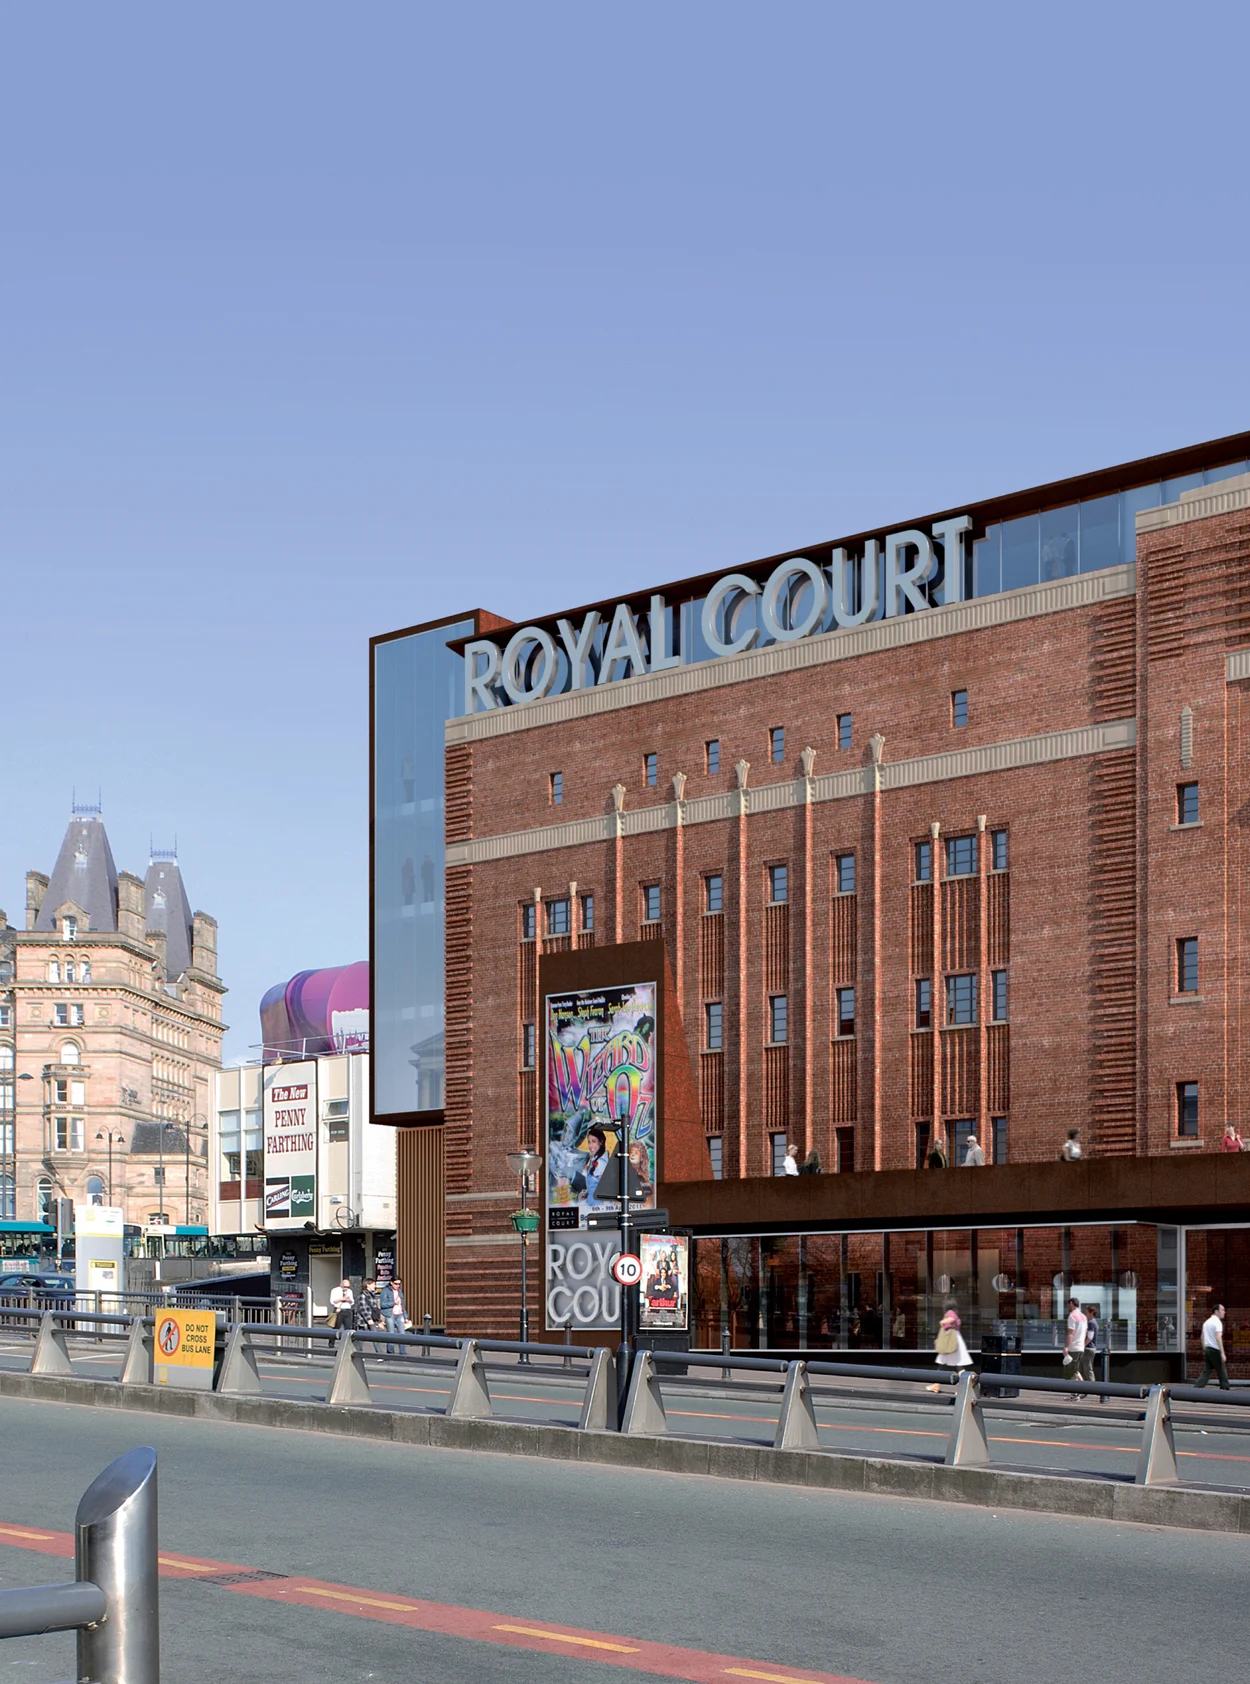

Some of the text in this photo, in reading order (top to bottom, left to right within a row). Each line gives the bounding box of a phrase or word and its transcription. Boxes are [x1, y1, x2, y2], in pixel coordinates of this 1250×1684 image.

[464, 514, 973, 714] ROYAL COURT
[549, 1028, 650, 1113] WIZARD
[273, 1086, 307, 1100] The New
[605, 1065, 653, 1139] OZ
[274, 1108, 307, 1128] PENNY
[267, 1132, 314, 1154] FARTHING
[620, 1264, 637, 1277] 10
[185, 1324, 209, 1333] DO NOT
[186, 1334, 208, 1343] CROSS
[181, 1344, 211, 1354] BUS LANE
